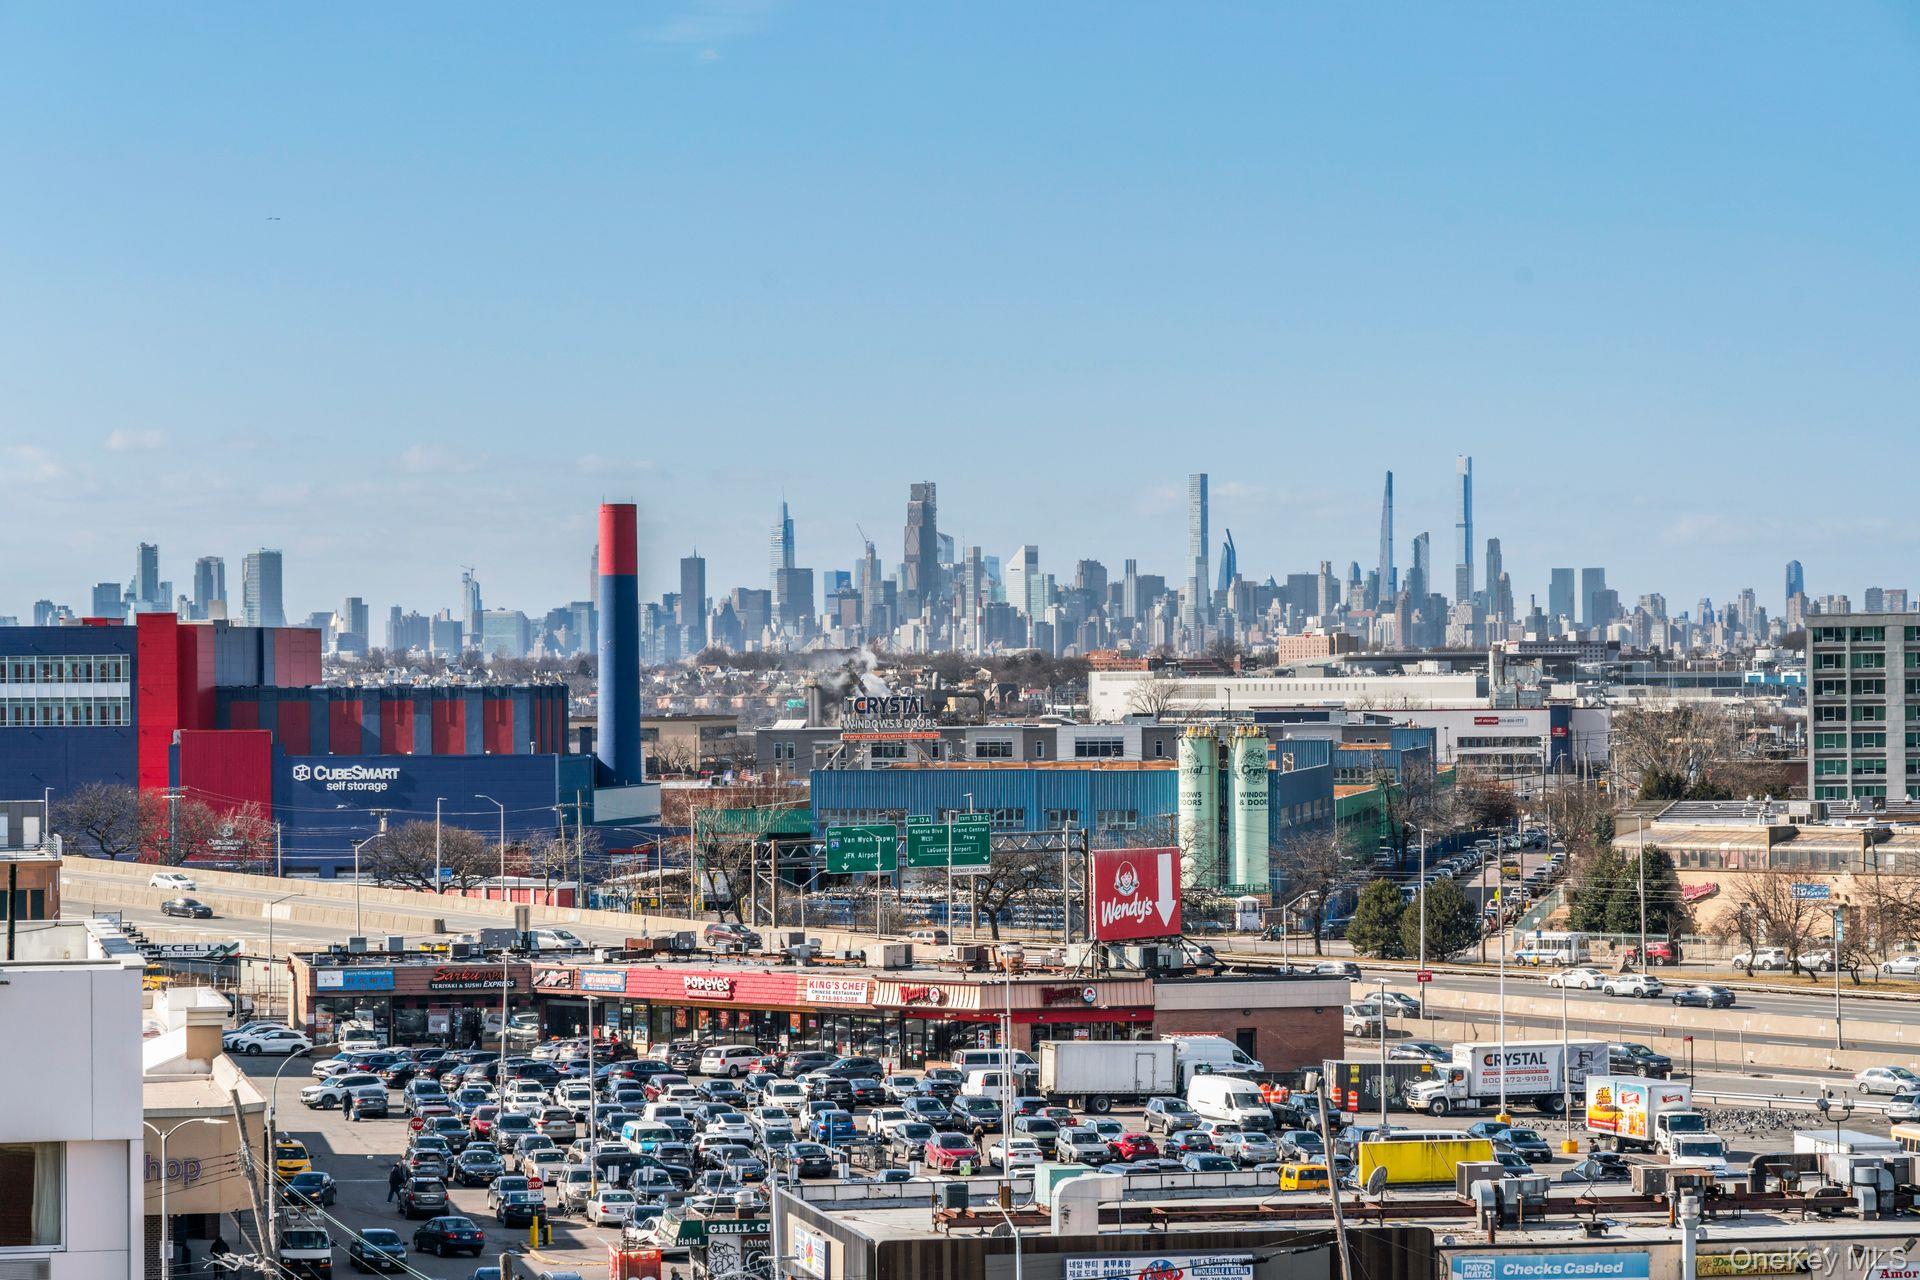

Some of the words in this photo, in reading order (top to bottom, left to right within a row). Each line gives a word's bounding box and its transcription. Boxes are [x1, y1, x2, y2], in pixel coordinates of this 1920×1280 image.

[854, 696, 930, 714] CRYSTAL
[844, 719, 895, 729] WINDOWS
[904, 718, 937, 728] DOORS
[326, 781, 347, 791] self
[347, 781, 388, 792] storage
[857, 835, 873, 844] Wyck
[953, 846, 972, 854] Airport
[843, 852, 855, 860] JFK
[1101, 893, 1153, 927] Wendy's
[432, 965, 480, 982] Sarku
[809, 980, 840, 989] KING'S
[842, 981, 866, 991] CHEF
[1484, 1052, 1548, 1067] CRYSTAL
[708, 1223, 750, 1234] GRILL
[678, 1237, 700, 1246] Halal
[1503, 1262, 1562, 1275] Checks
[1564, 1261, 1623, 1275] Cashed
[1880, 1269, 1919, 1279] Amor
